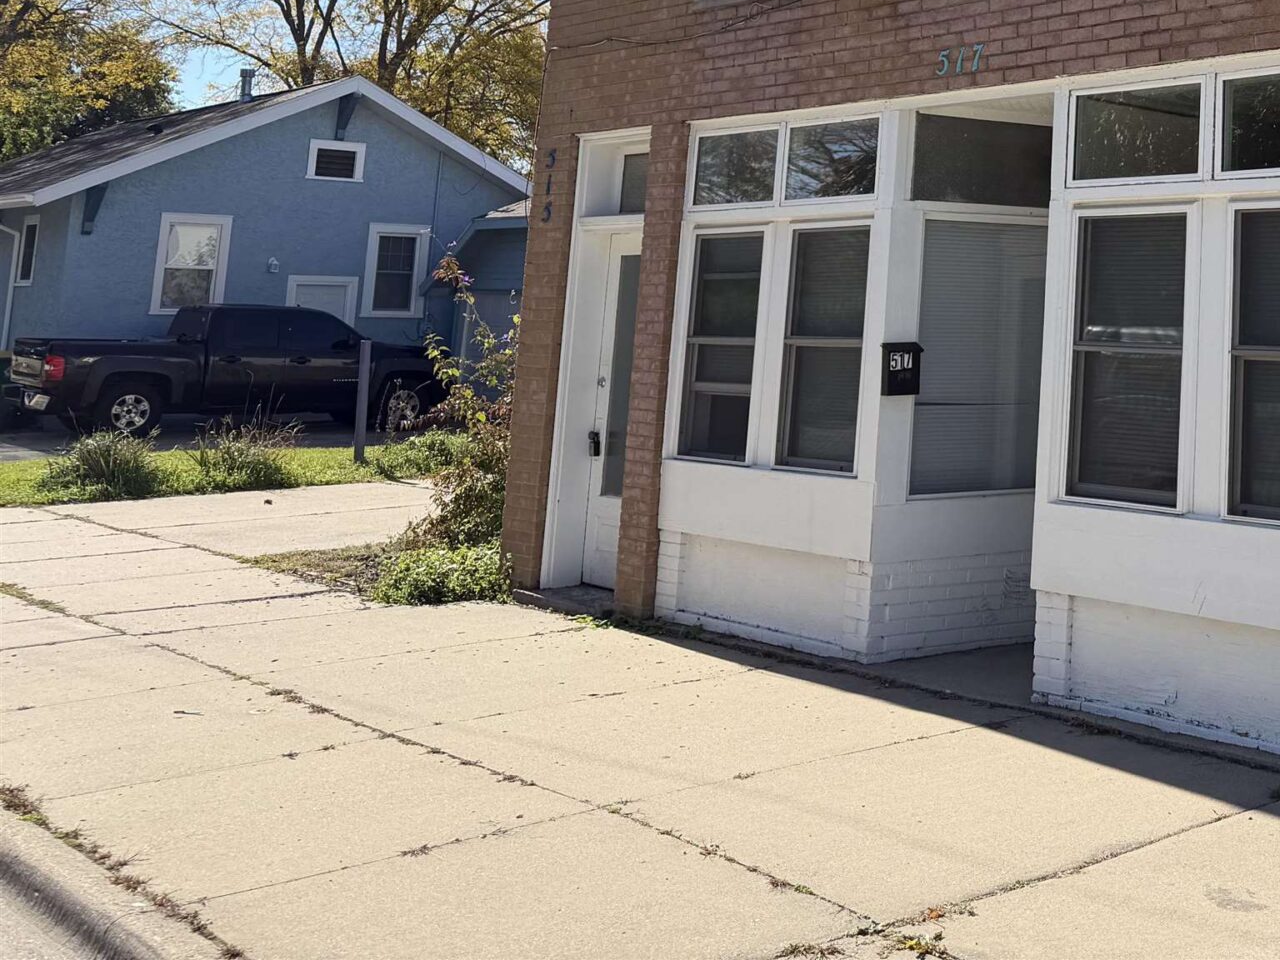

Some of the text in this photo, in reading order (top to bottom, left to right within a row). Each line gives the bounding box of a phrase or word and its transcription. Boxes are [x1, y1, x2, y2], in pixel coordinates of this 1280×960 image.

[935, 42, 985, 76] 517
[541, 148, 557, 224] 515
[889, 351, 913, 371] 517
